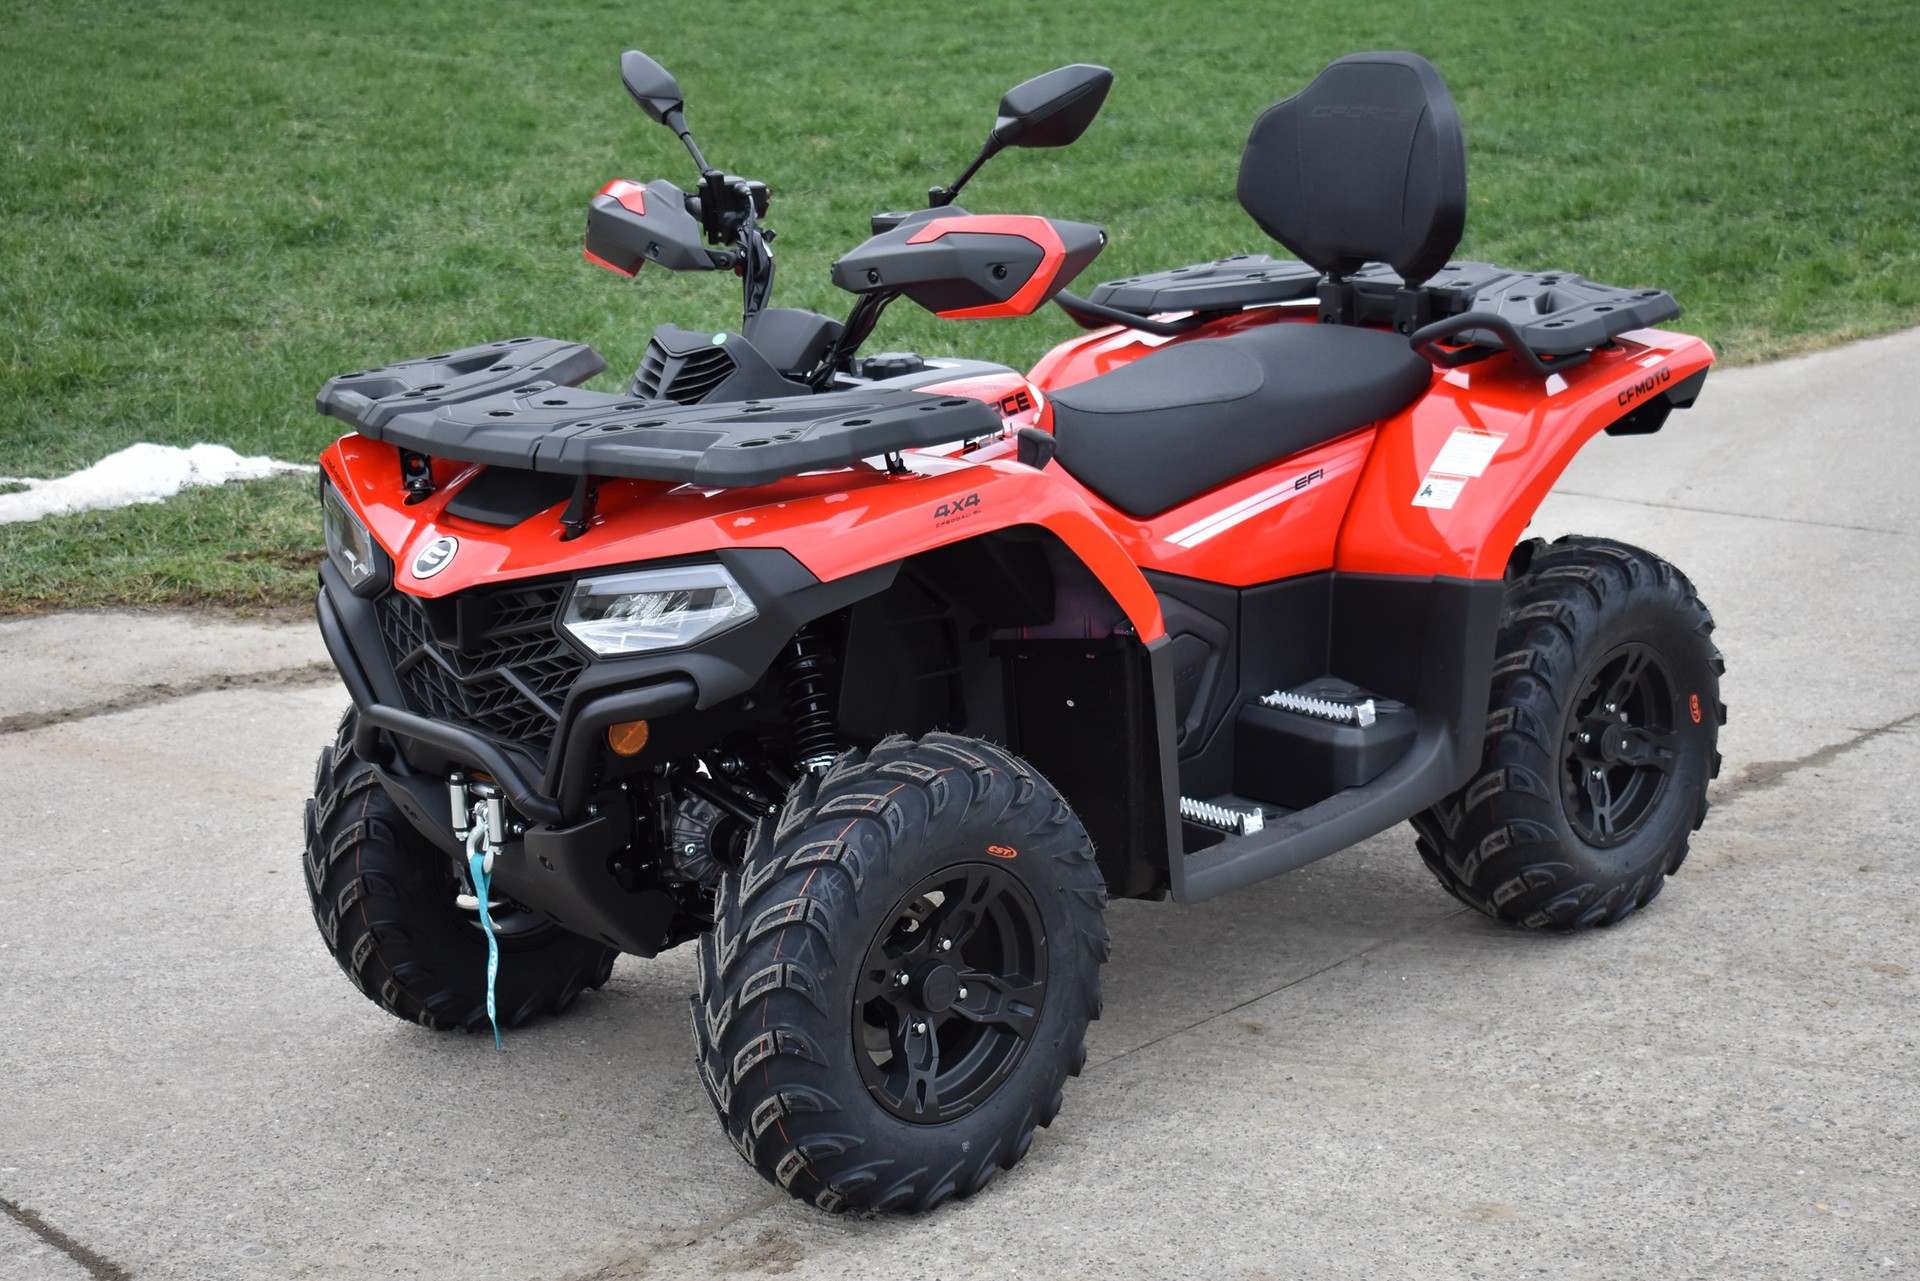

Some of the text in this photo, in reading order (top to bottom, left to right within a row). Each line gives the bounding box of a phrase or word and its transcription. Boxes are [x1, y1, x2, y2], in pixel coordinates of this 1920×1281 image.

[1311, 105, 1415, 121] CFORCE
[1618, 367, 1671, 406] CFMOTO
[1295, 468, 1324, 491] EFI
